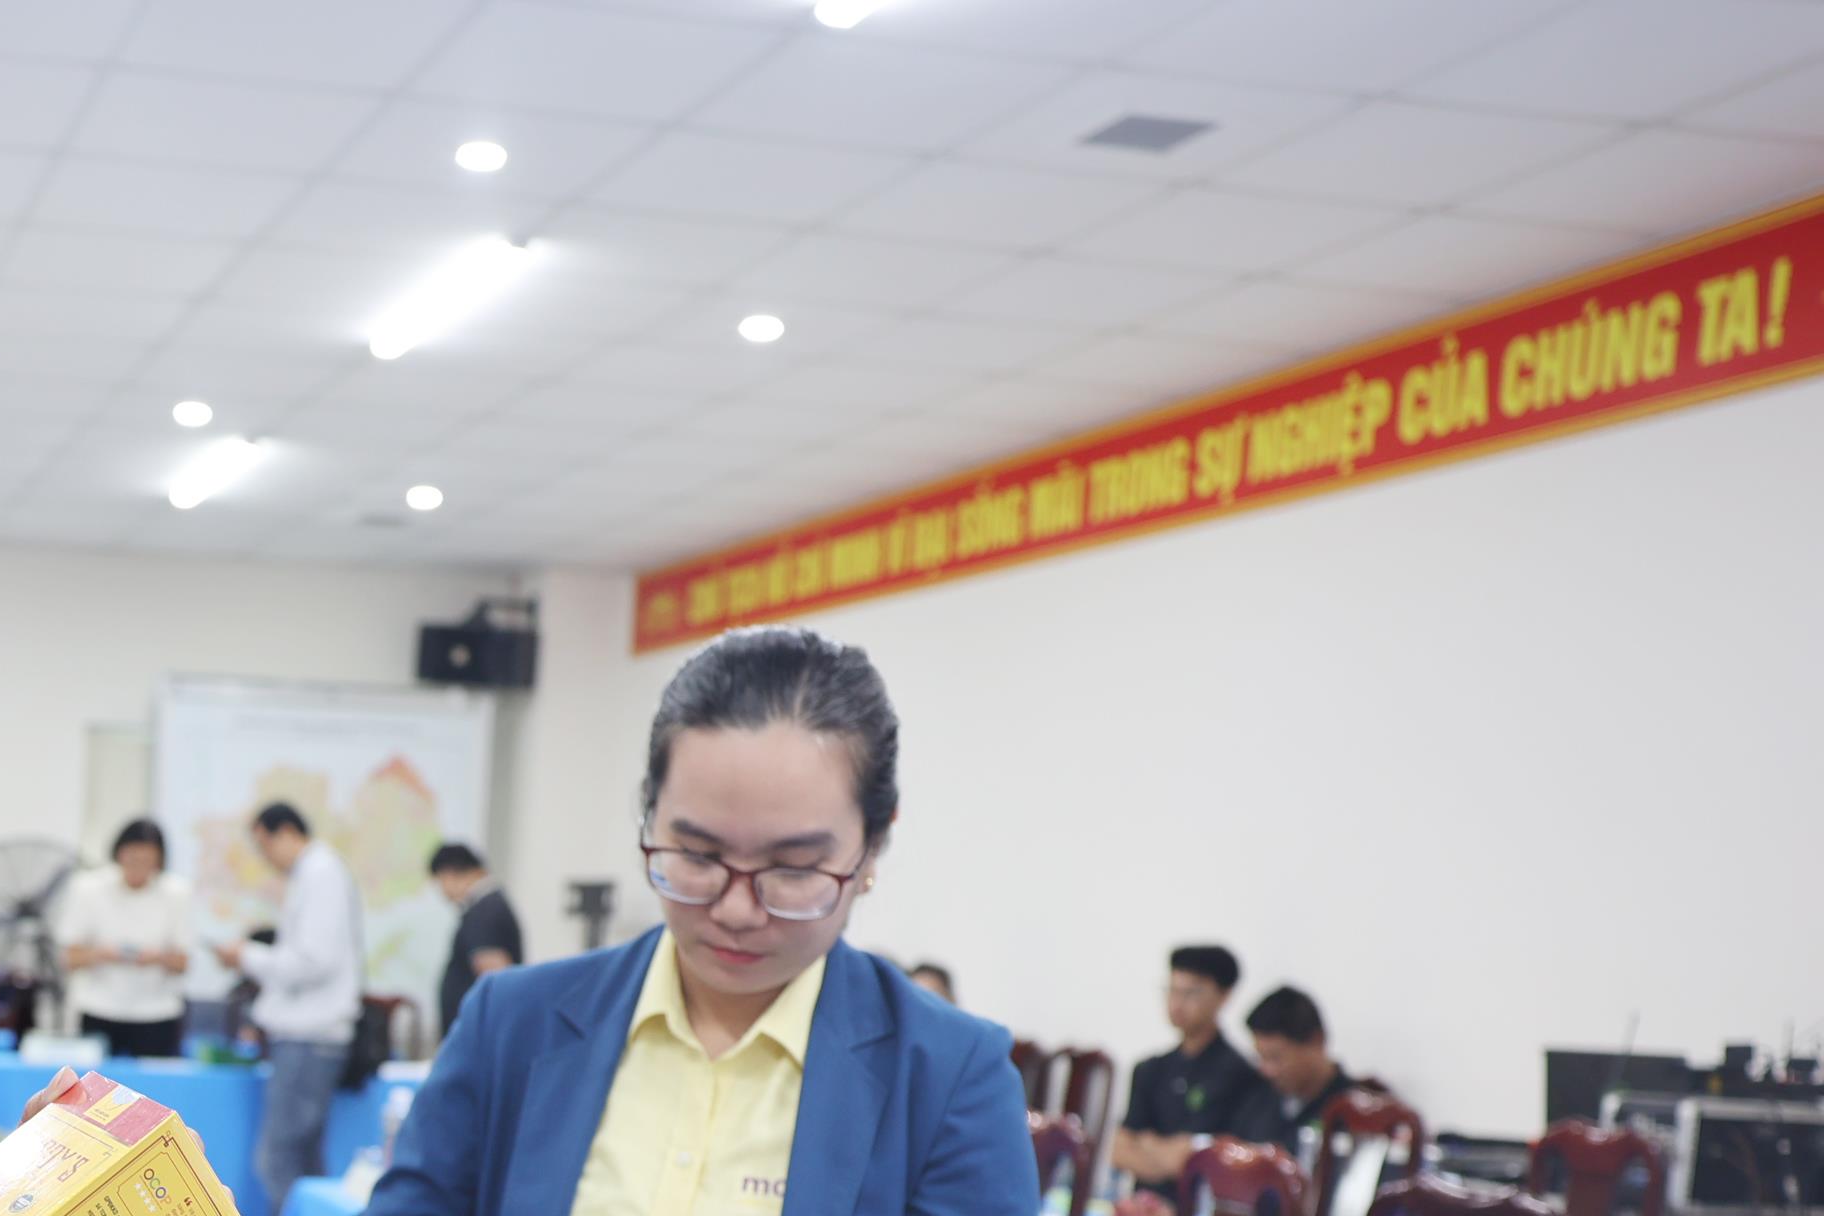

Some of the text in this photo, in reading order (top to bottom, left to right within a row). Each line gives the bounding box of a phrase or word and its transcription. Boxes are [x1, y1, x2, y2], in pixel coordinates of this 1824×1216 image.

[1087, 436, 1192, 526] TRONG
[1193, 413, 1250, 506] SỰ
[1246, 370, 1393, 478] NGHIỆP
[1397, 331, 1490, 446] CỦA
[1498, 298, 1682, 417] CHÚNG
[144, 1168, 172, 1204] OCOP
